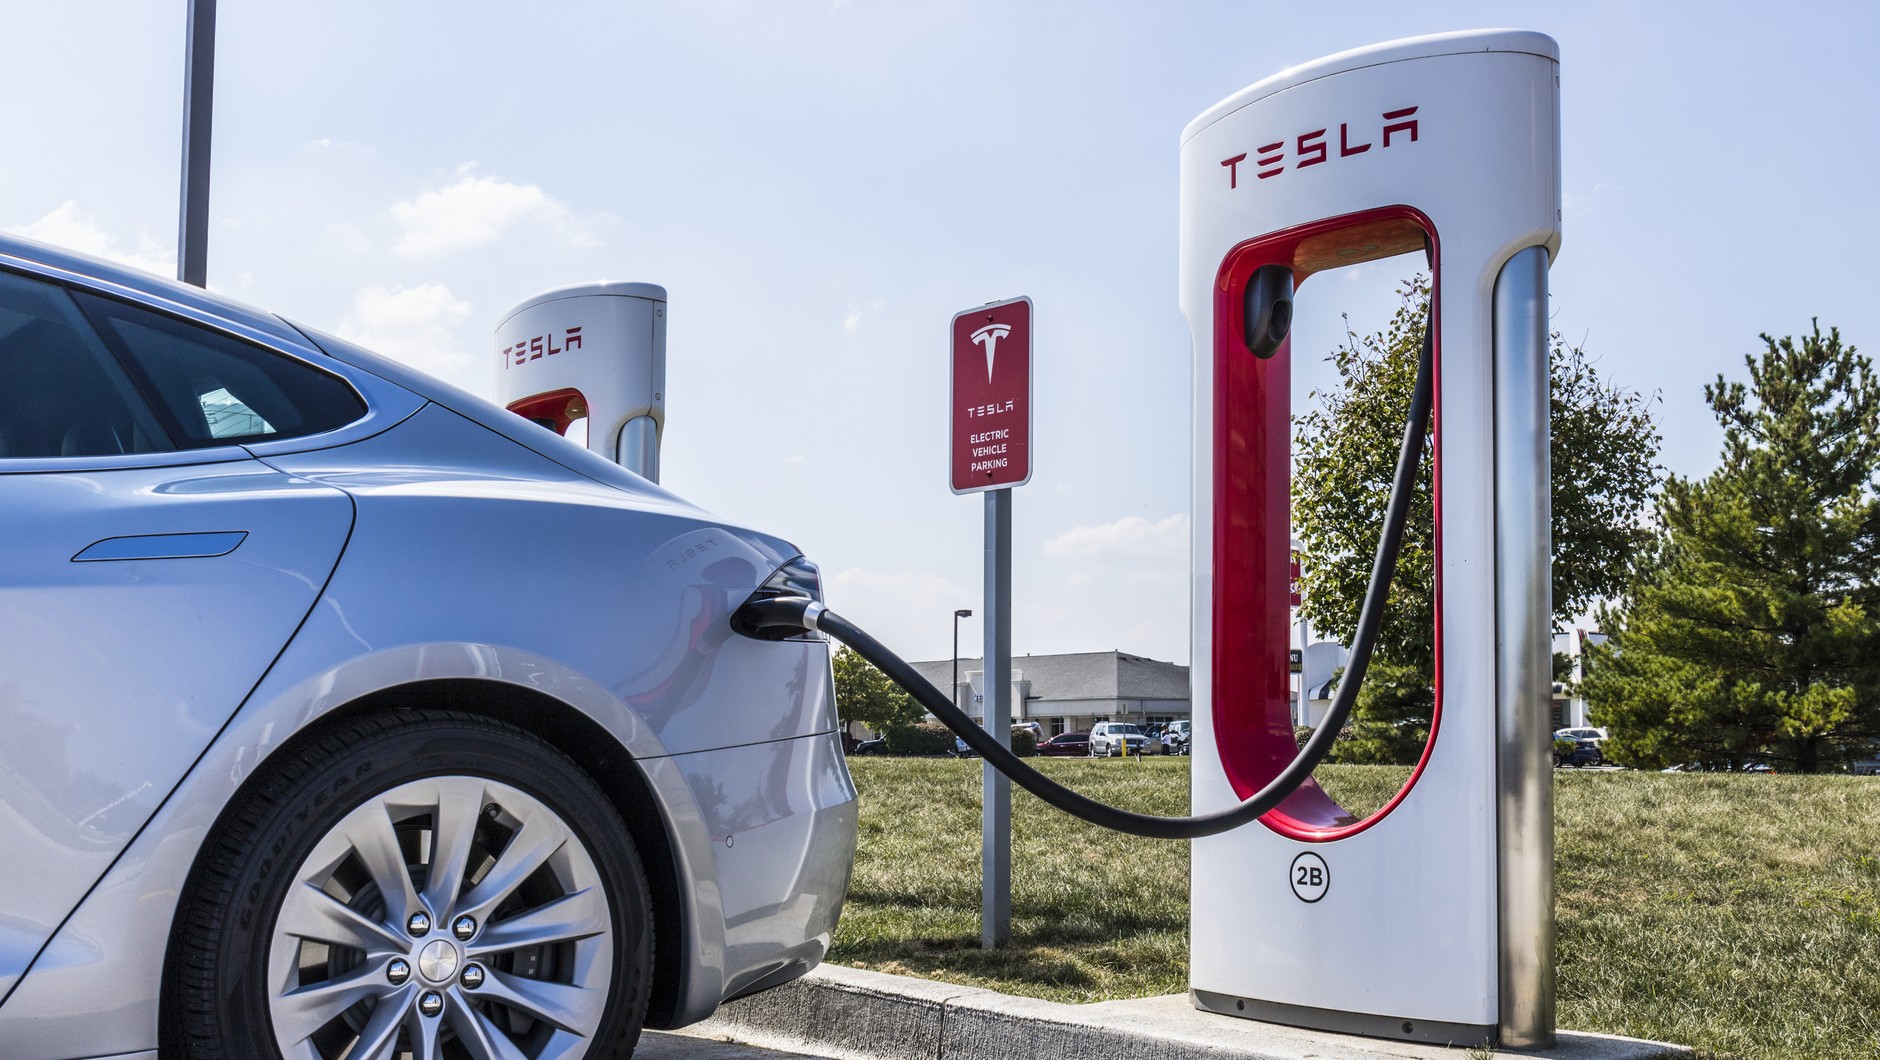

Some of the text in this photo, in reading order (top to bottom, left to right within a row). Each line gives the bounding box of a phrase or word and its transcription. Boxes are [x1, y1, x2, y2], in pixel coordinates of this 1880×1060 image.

[1220, 105, 1419, 190] TESLA
[503, 326, 582, 370] TESLA
[967, 400, 1014, 418] TESLA
[970, 428, 1009, 444] ELECTRIC
[972, 443, 1007, 458] VEHICLE
[971, 457, 1008, 472] PARKING
[240, 761, 373, 930] GOODYEAR
[1296, 866, 1323, 887] 2B
